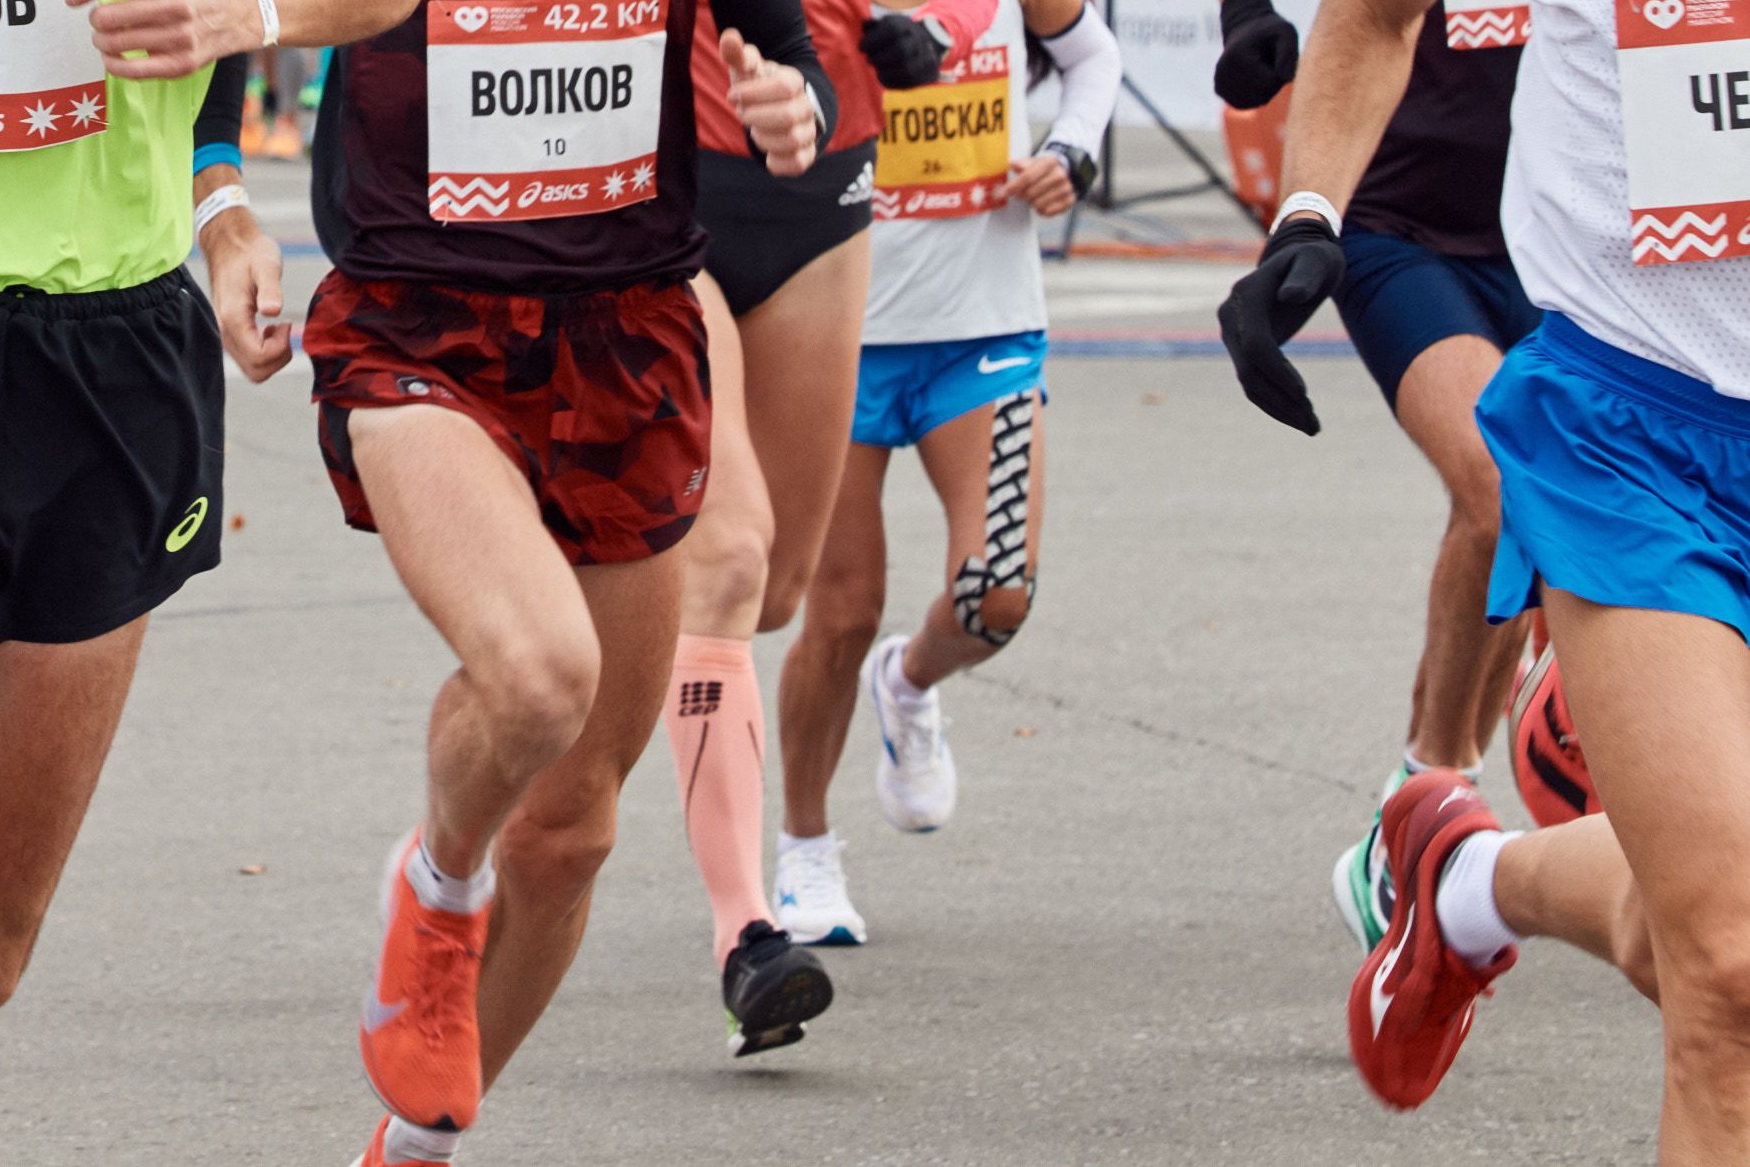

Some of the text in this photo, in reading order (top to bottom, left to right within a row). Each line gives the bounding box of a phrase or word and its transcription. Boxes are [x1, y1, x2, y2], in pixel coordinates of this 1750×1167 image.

[544, 3, 608, 33] 42,2
[617, 0, 659, 28] КМ
[471, 64, 633, 117] ВОЛКОВ
[543, 138, 566, 157] 10
[540, 182, 589, 202] asics
